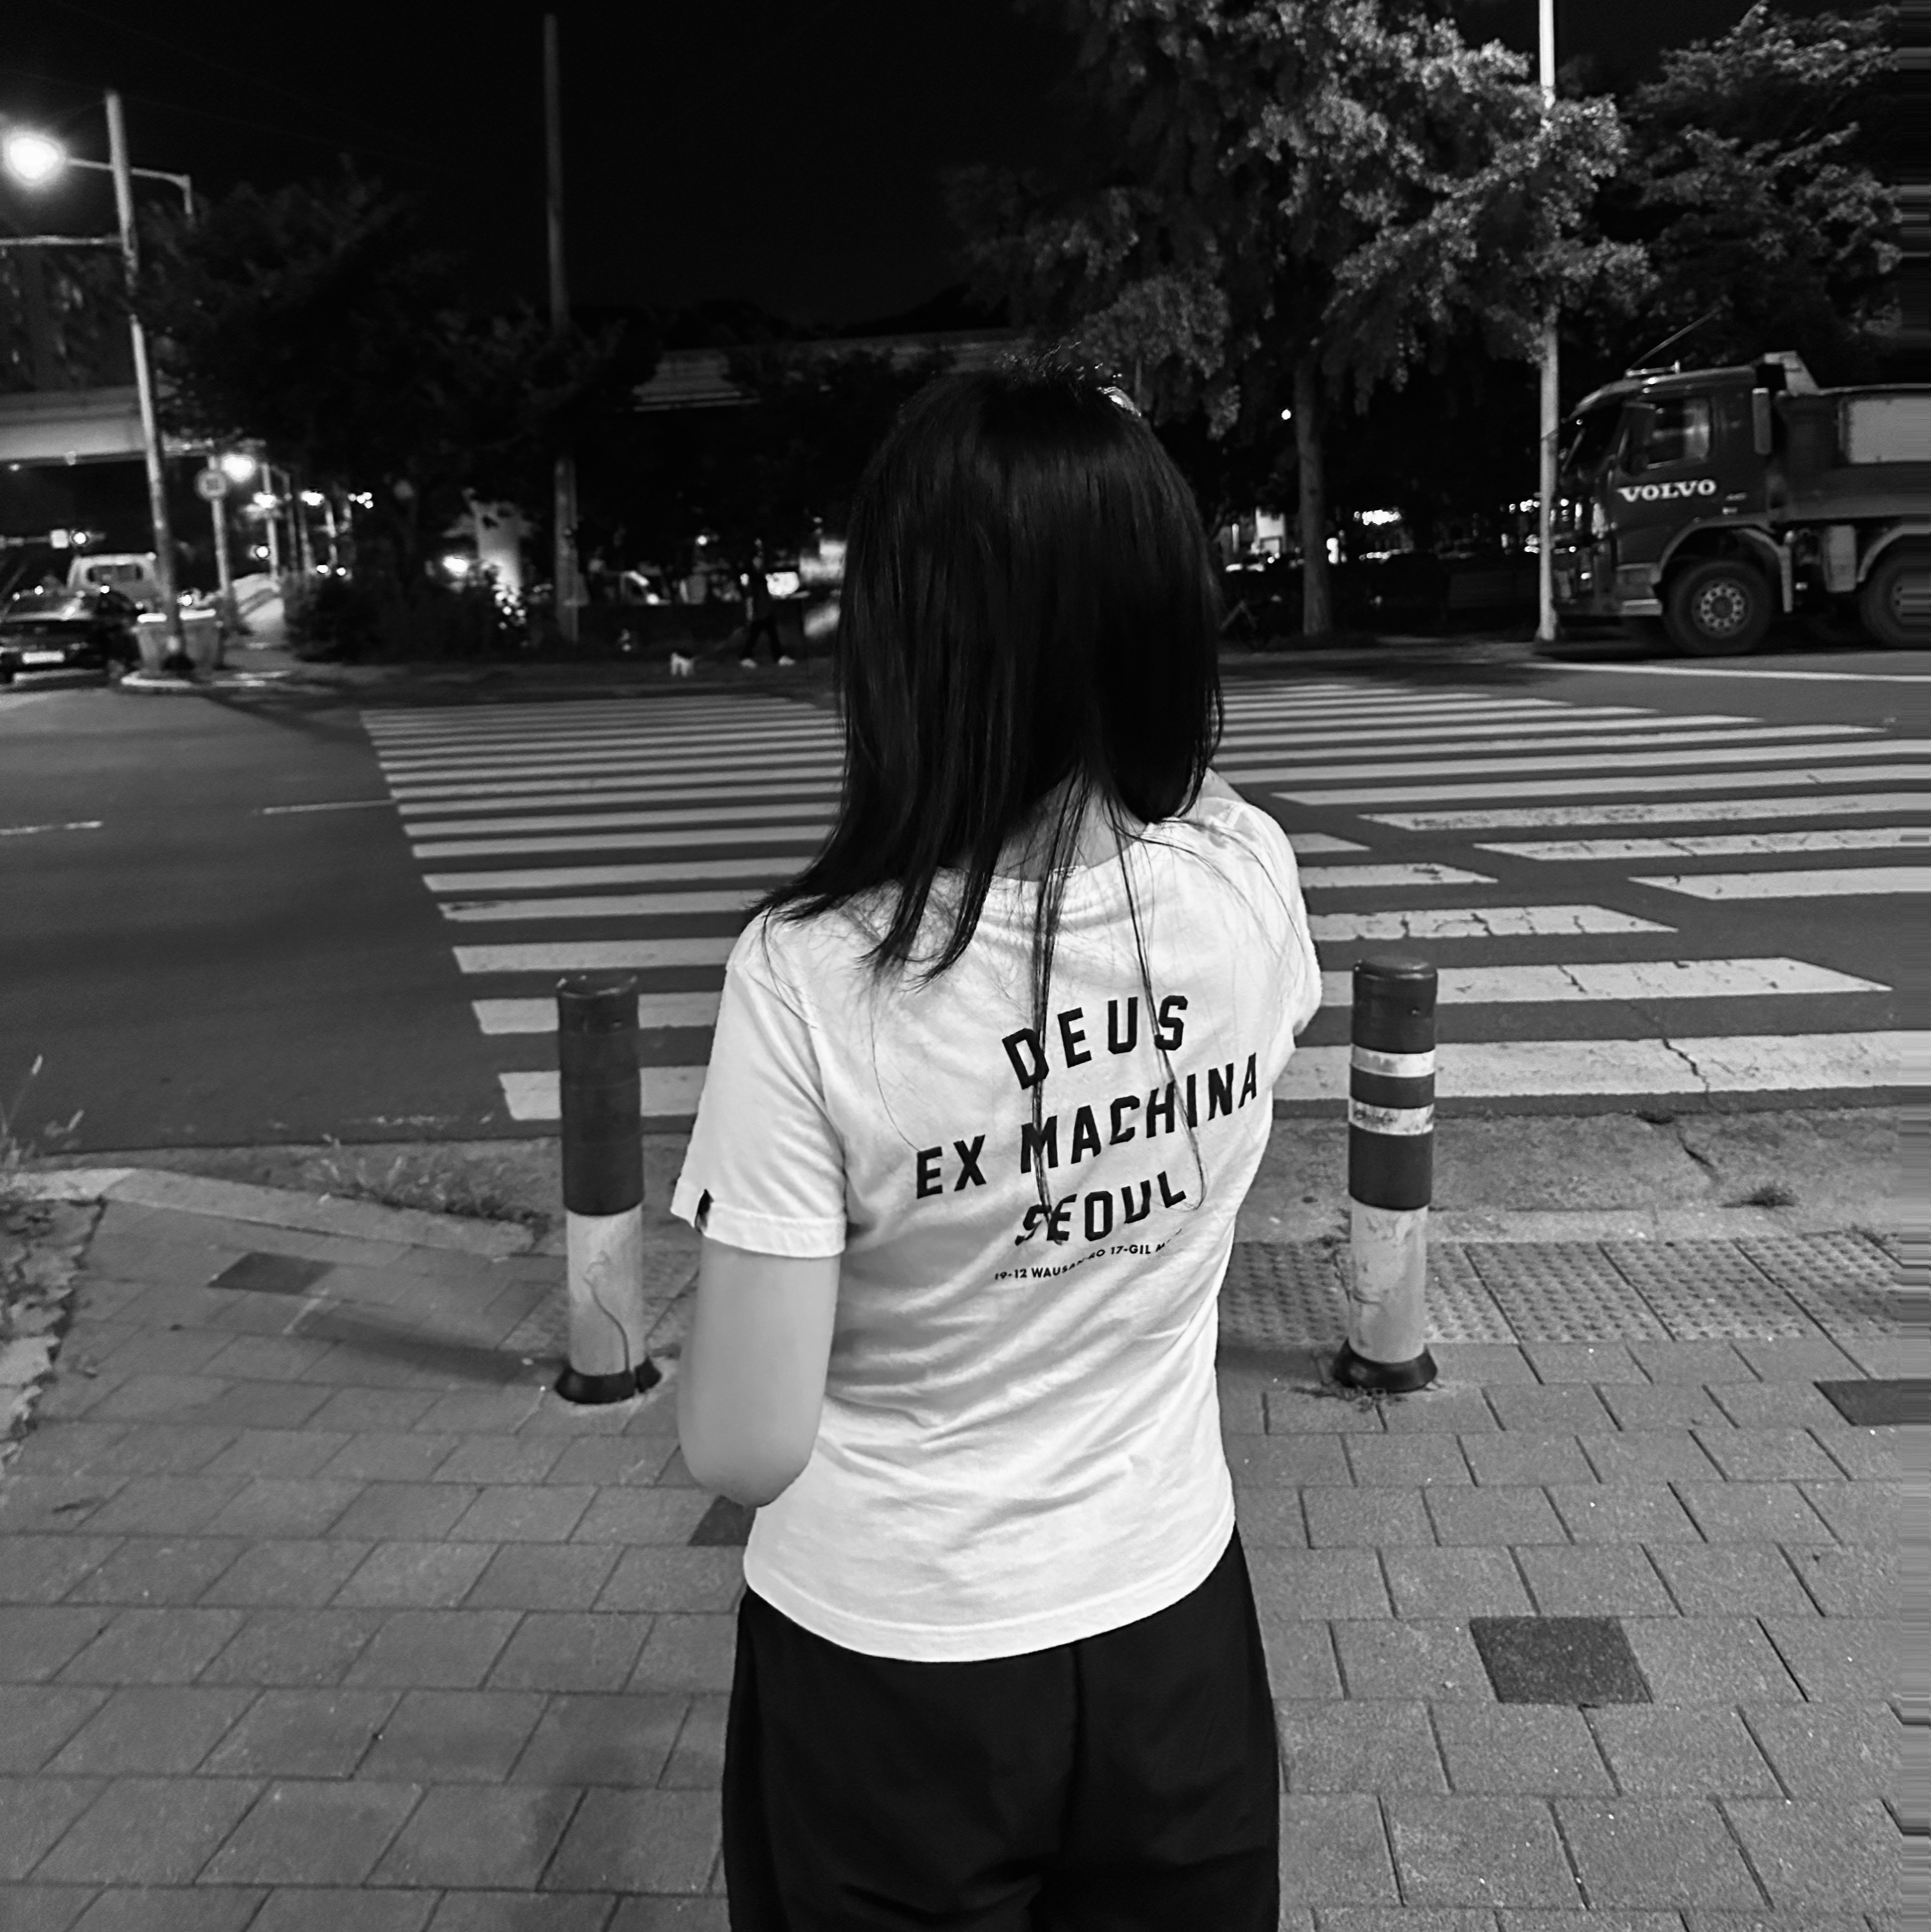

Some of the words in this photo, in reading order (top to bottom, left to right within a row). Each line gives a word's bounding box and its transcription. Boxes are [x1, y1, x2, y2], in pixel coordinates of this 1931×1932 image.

[1617, 479, 1716, 502] VOLVO
[1002, 996, 1188, 1090] DEUS
[917, 1134, 986, 1199] EX
[1021, 1053, 1257, 1174] MACHINA
[1014, 1171, 1186, 1245] SEOUL
[995, 1268, 1027, 1280] 19-12
[1111, 1244, 1151, 1255] 17-GIL
